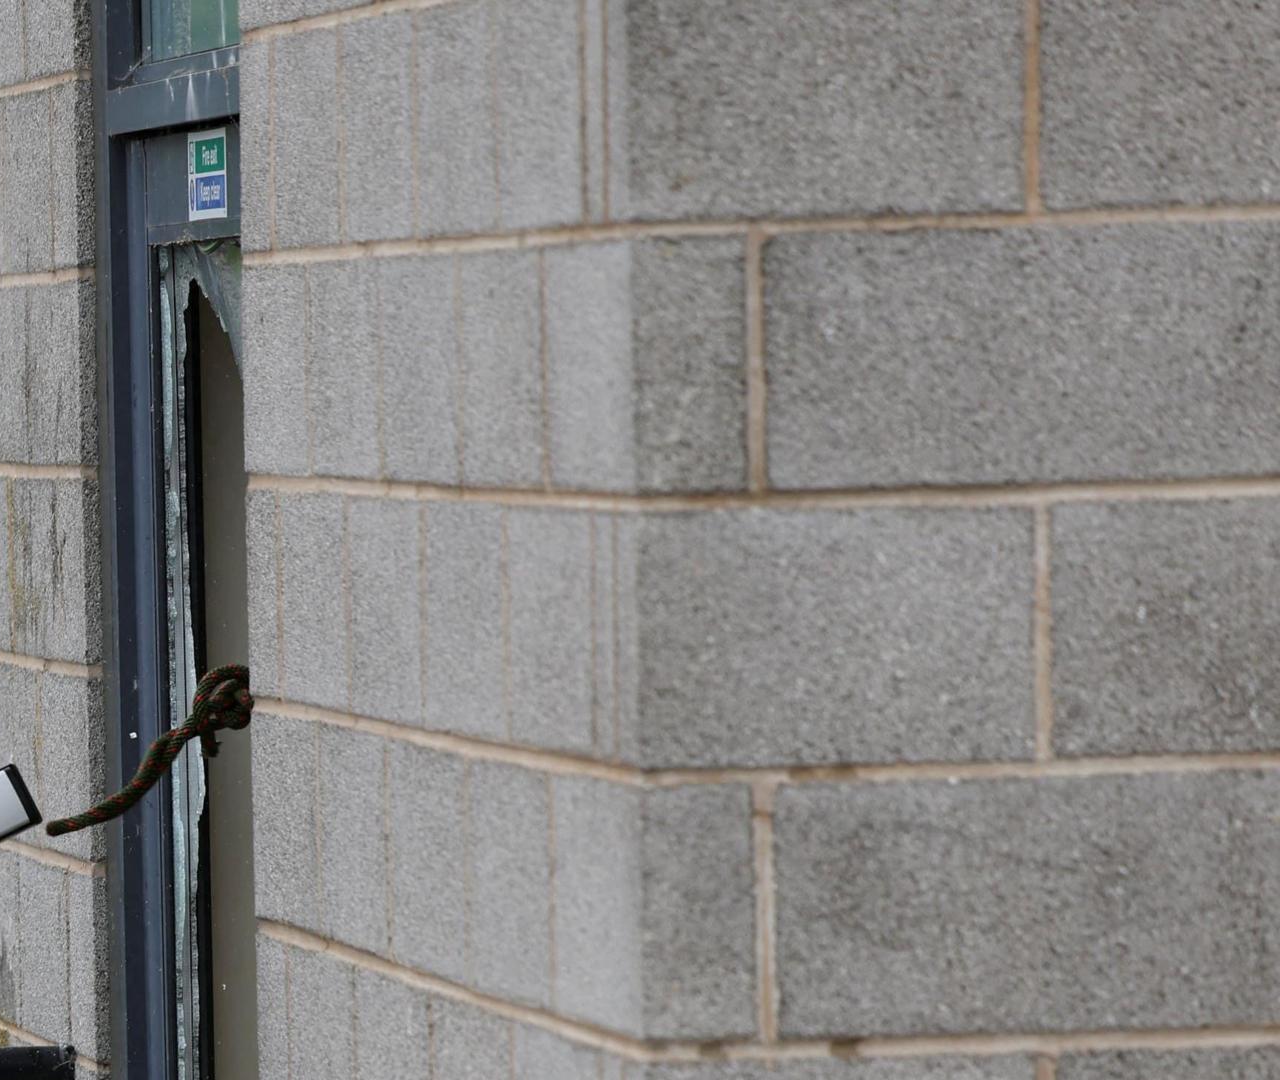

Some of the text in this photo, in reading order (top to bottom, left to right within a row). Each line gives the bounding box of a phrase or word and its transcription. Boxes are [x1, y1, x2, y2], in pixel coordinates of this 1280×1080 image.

[201, 143, 218, 167] Fire exit
[200, 180, 221, 207] Keep clear
